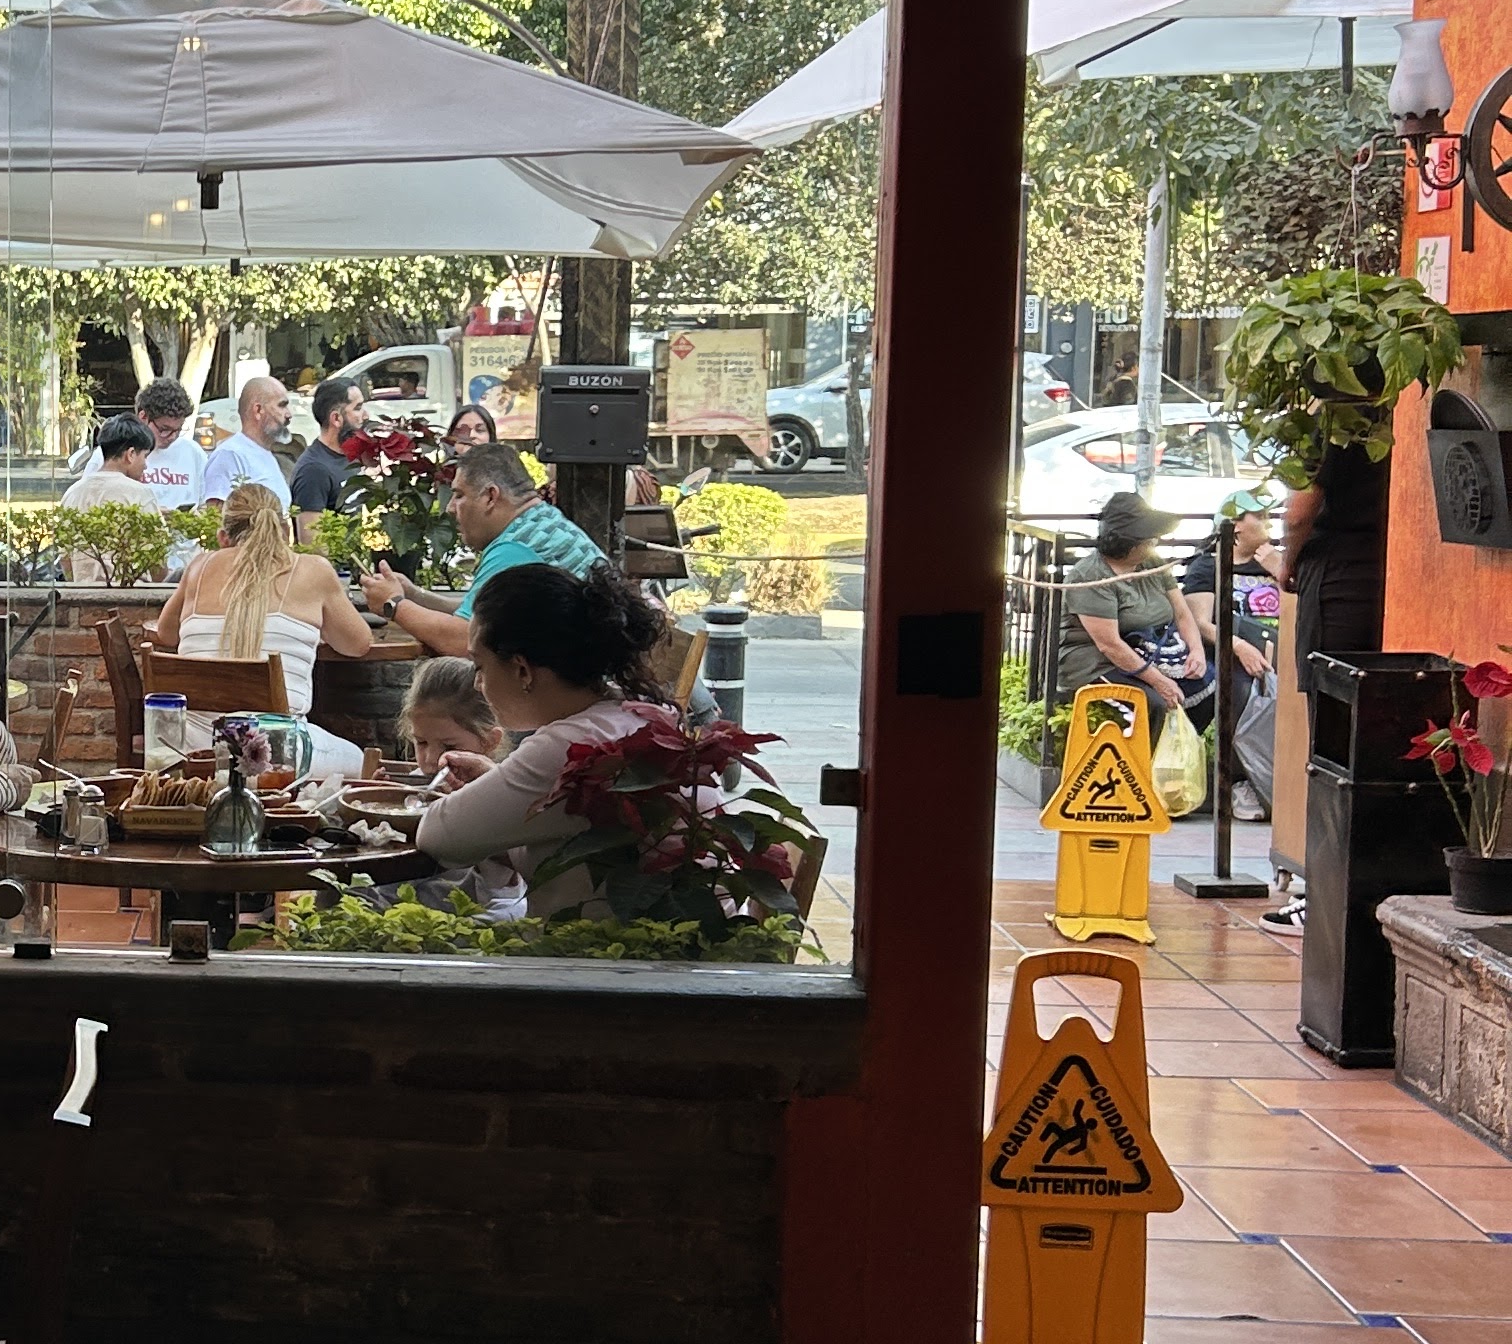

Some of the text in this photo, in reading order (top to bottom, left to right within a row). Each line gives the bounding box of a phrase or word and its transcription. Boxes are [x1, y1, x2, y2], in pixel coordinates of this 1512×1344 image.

[568, 373, 624, 386] BUZÓN
[1067, 758, 1099, 801] CAUTION
[1116, 759, 1147, 804] CUIDADO
[1075, 812, 1135, 823] ATTENTION
[1001, 1081, 1060, 1158] CAUTION
[1090, 1085, 1141, 1161] CUIDADO
[1016, 1176, 1122, 1197] ATTENTION
